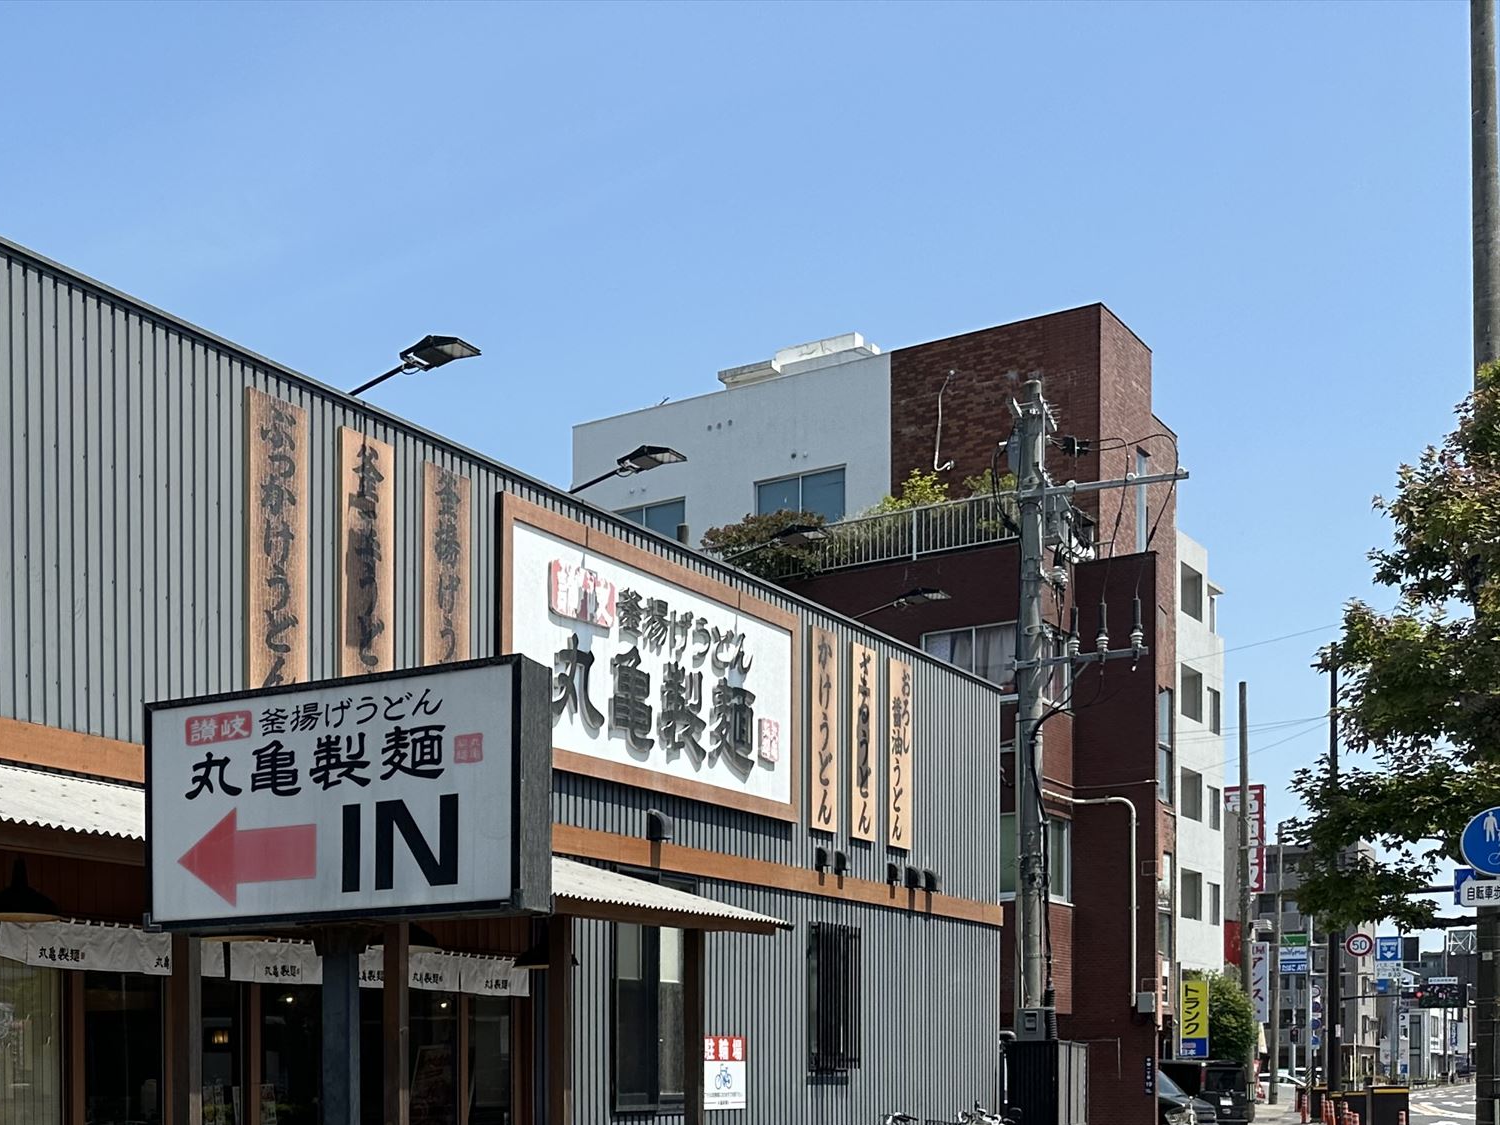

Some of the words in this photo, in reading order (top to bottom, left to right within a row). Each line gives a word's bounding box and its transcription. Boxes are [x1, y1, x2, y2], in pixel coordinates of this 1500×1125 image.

[352, 443, 385, 672] 釜玉うど
[435, 472, 461, 663] 釜揚げう
[617, 587, 754, 674] 釜揚げうどん
[258, 688, 443, 737] 釜揚げうどん
[552, 633, 757, 783] 丸亀製麺
[818, 636, 833, 825] かけうどん
[185, 724, 446, 800] 丸亀製麺
[342, 793, 459, 893] IN
[38, 946, 80, 962] 丸亀製麺
[265, 965, 296, 978] 丸亀製麺
[1352, 940, 1367, 950] 50
[1184, 984, 1199, 1035] トランク
[704, 1038, 743, 1060] 駐輪場
